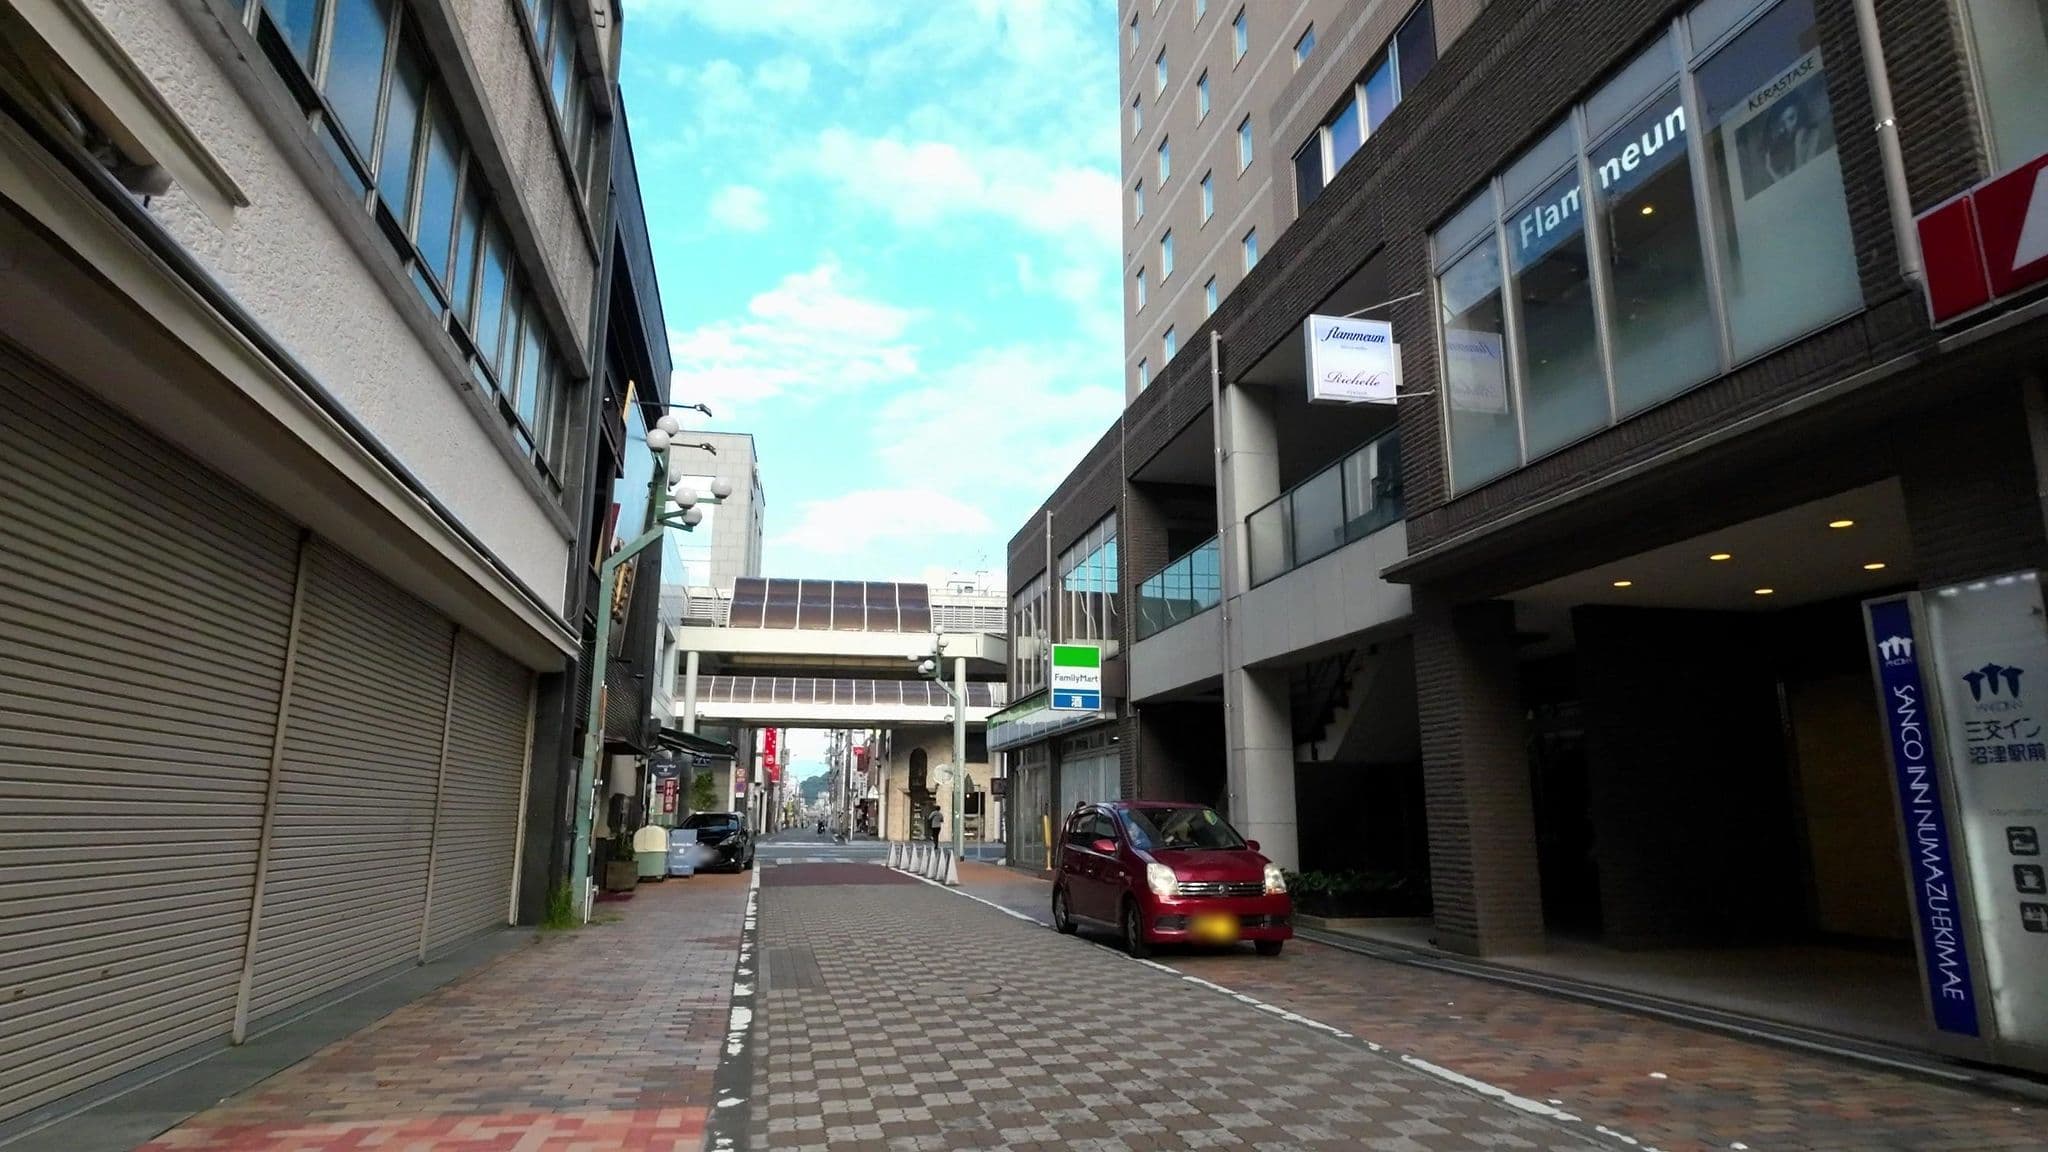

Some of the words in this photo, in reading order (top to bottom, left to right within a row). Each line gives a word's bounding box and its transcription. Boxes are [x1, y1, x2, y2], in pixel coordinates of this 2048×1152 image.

[1324, 369, 1387, 386] Richelle
[1054, 673, 1099, 683] FamilyMart
[1071, 695, 1083, 708] 酒
[1893, 685, 1924, 760] SANCO
[1965, 717, 2041, 742] 三交イン
[1969, 743, 2047, 764] 沼津駅前
[1907, 766, 1932, 803] INN
[1913, 809, 1964, 1000] NUMAZU-EKIMAE
